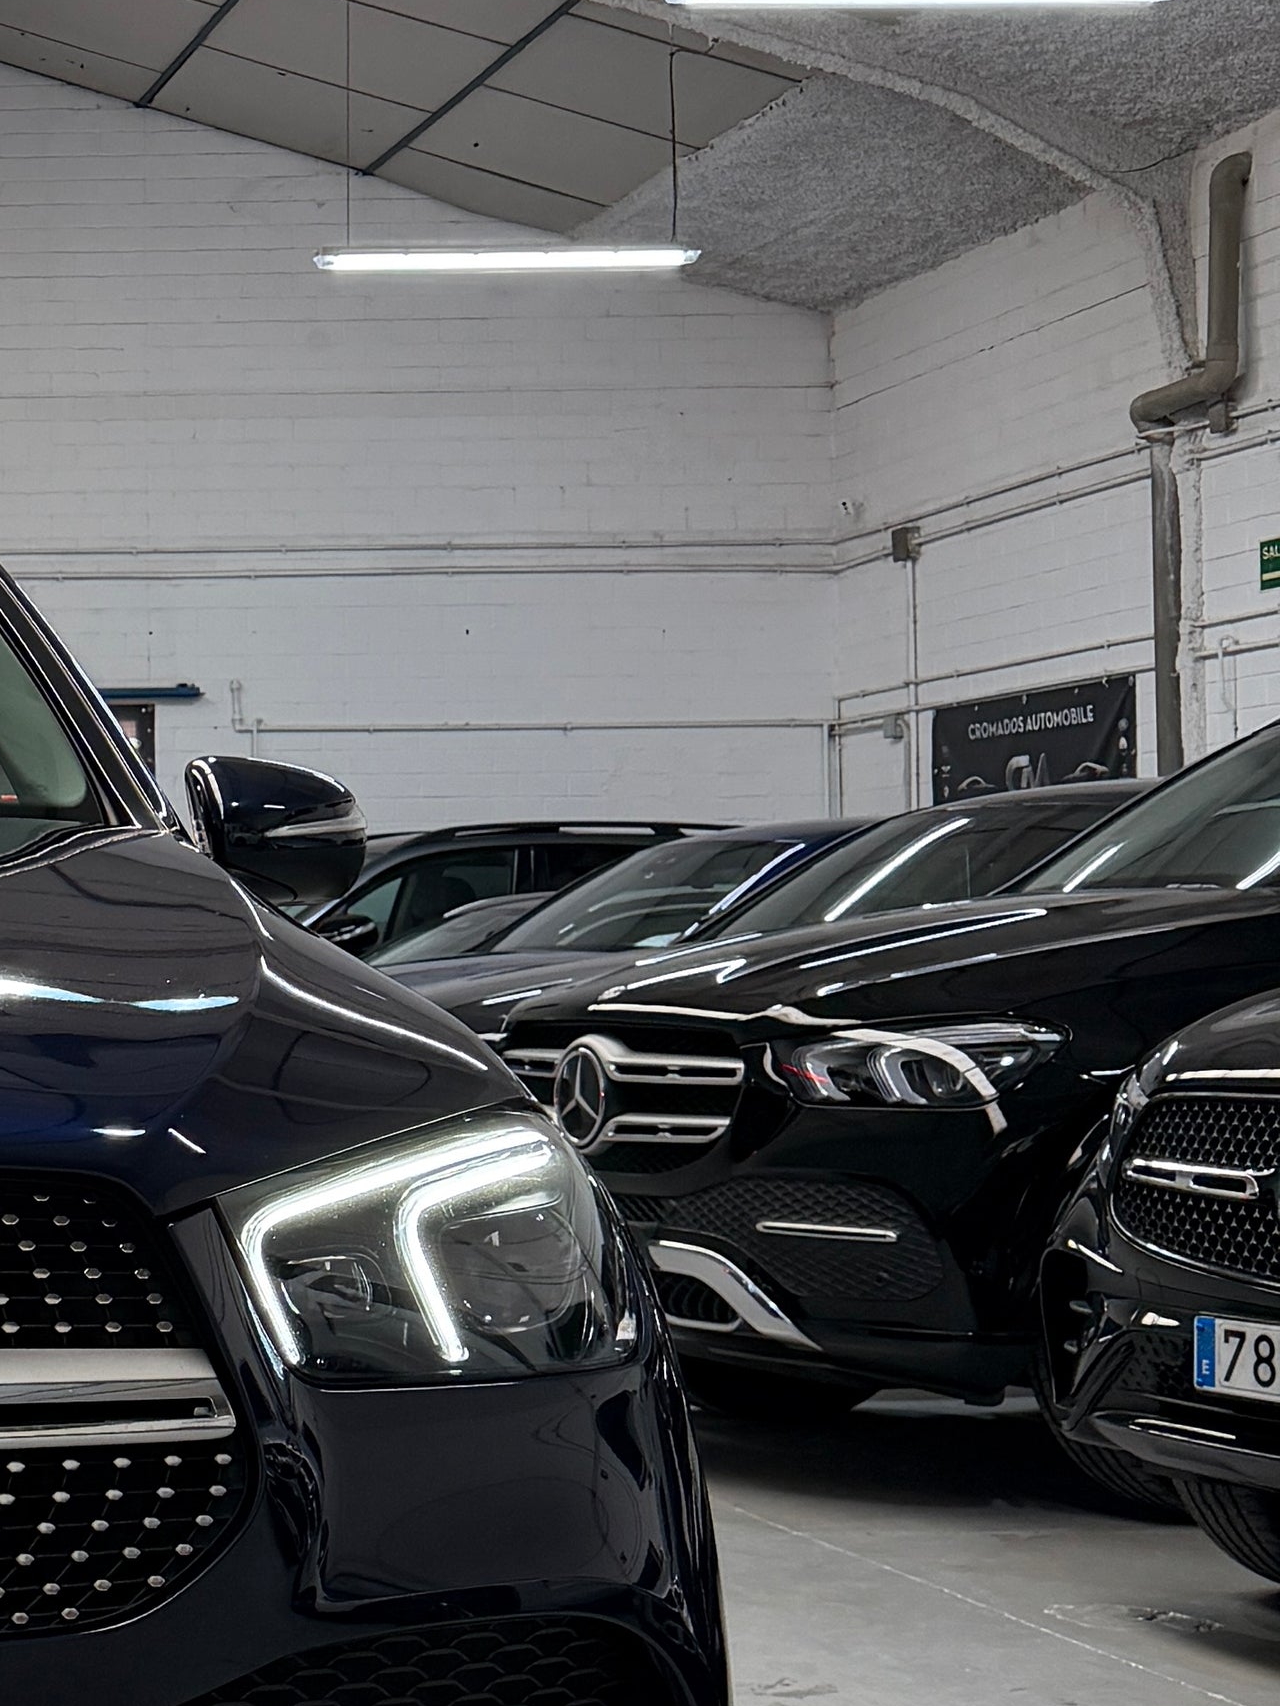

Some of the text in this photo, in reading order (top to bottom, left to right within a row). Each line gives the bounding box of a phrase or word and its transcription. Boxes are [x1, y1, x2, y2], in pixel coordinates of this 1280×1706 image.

[968, 704, 1095, 741] CROMADOS AUTOMOBILE
[1201, 1328, 1277, 1388] E 78
